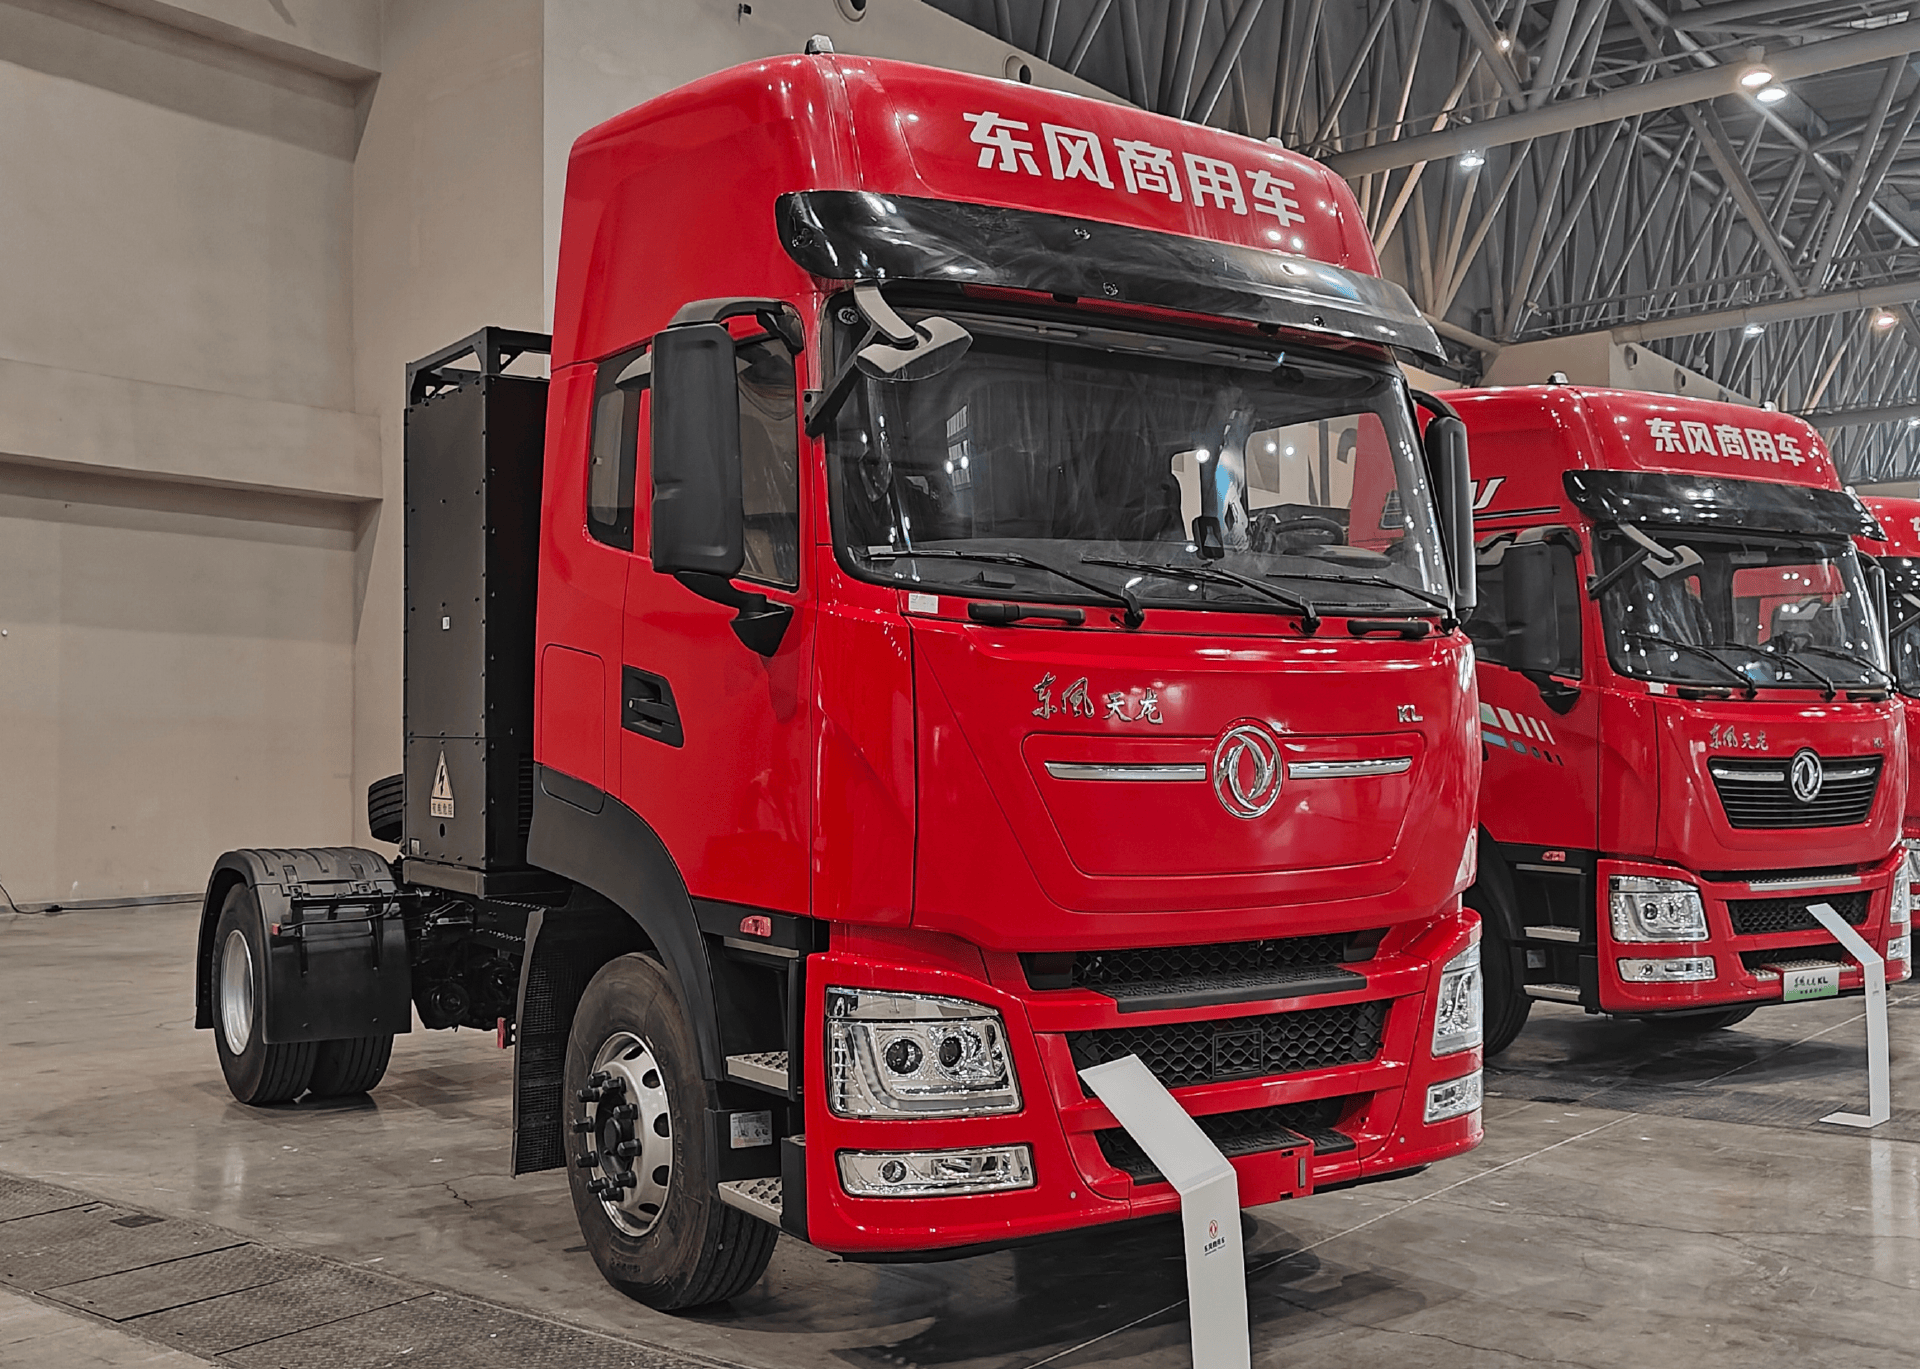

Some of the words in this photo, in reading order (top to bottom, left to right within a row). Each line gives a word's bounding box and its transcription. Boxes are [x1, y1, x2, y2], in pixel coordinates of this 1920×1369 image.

[963, 111, 1305, 227] 东风商用车
[1645, 417, 1806, 467] 东风商用车
[1397, 704, 1424, 723] KL
